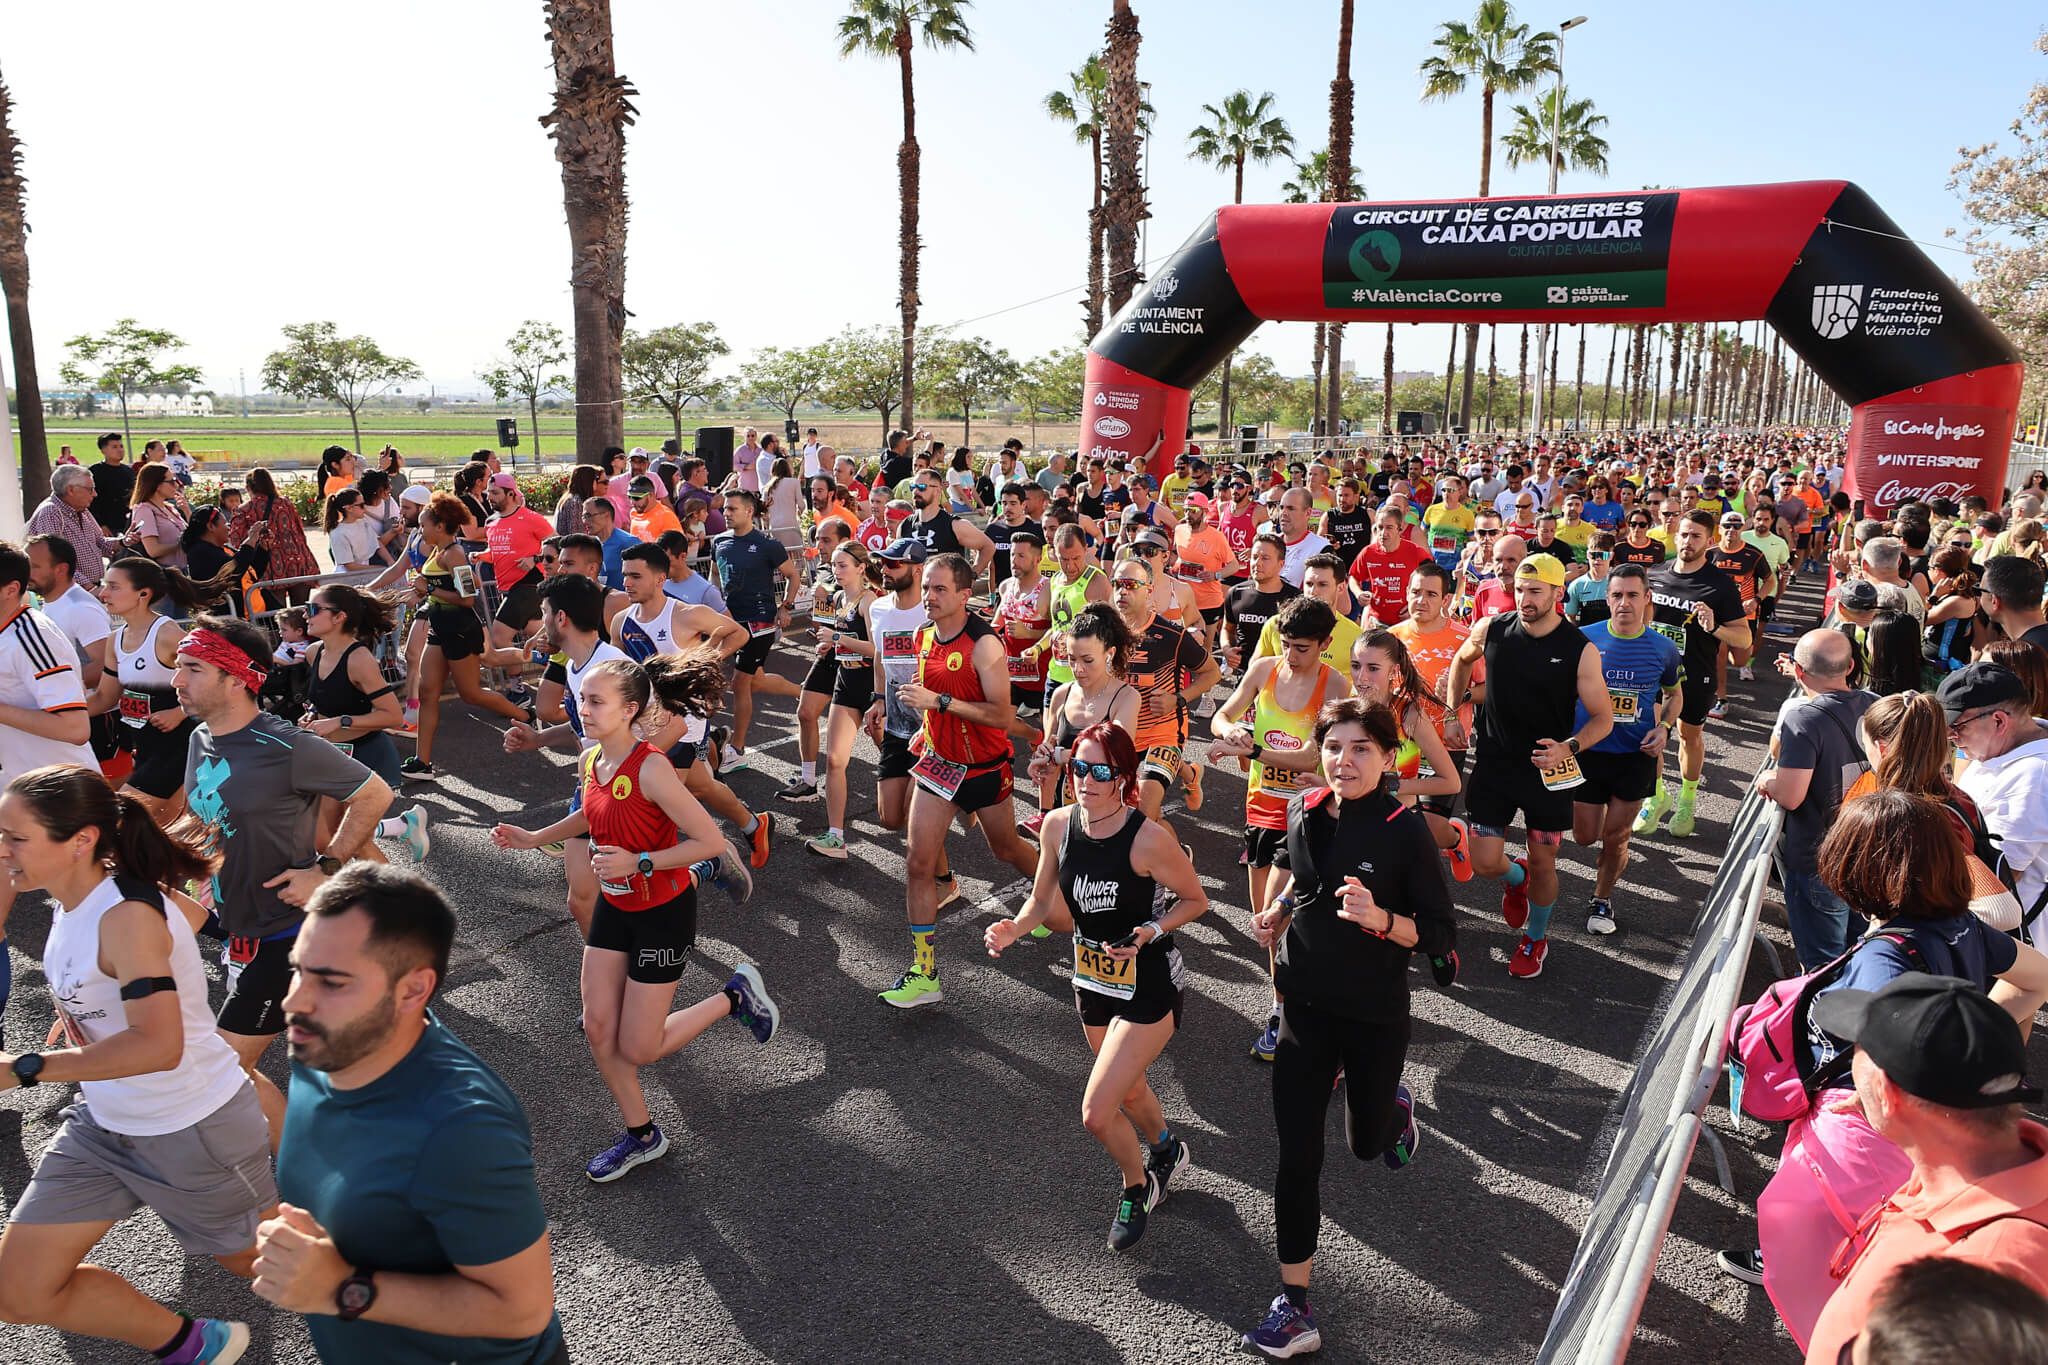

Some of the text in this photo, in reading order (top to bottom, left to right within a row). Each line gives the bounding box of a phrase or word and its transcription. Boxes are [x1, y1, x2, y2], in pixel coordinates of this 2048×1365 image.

[1352, 200, 1644, 225] CIRCUIT DE CARRERES
[1508, 244, 1550, 257] CIUTAT
[1555, 244, 1572, 256] DE
[1352, 288, 1502, 303] #ValènciaCorre
[1571, 285, 1608, 295] caixa
[1870, 287, 1940, 301] Fundació
[1571, 292, 1629, 303] popular
[1868, 300, 1942, 313] Esportiva
[1865, 312, 1943, 325] Municipal
[1120, 319, 1204, 334] DE VALÈNCIA
[1864, 324, 1931, 336] València
[1107, 402, 1138, 411] ALFONSO
[1108, 396, 1139, 405] TRINIDAD
[1098, 421, 1127, 434] Serrano
[1898, 420, 1934, 434] Corte
[1892, 454, 1981, 470] INTERSPORT
[885, 637, 912, 651] 283
[135, 657, 146, 671] C
[1606, 669, 1634, 681] CEU
[1269, 734, 1300, 748] Serrano
[920, 756, 961, 786] 2686
[1073, 874, 1119, 902] WONDER
[1077, 896, 1117, 913] WOMAN
[1080, 954, 1130, 978] 4137
